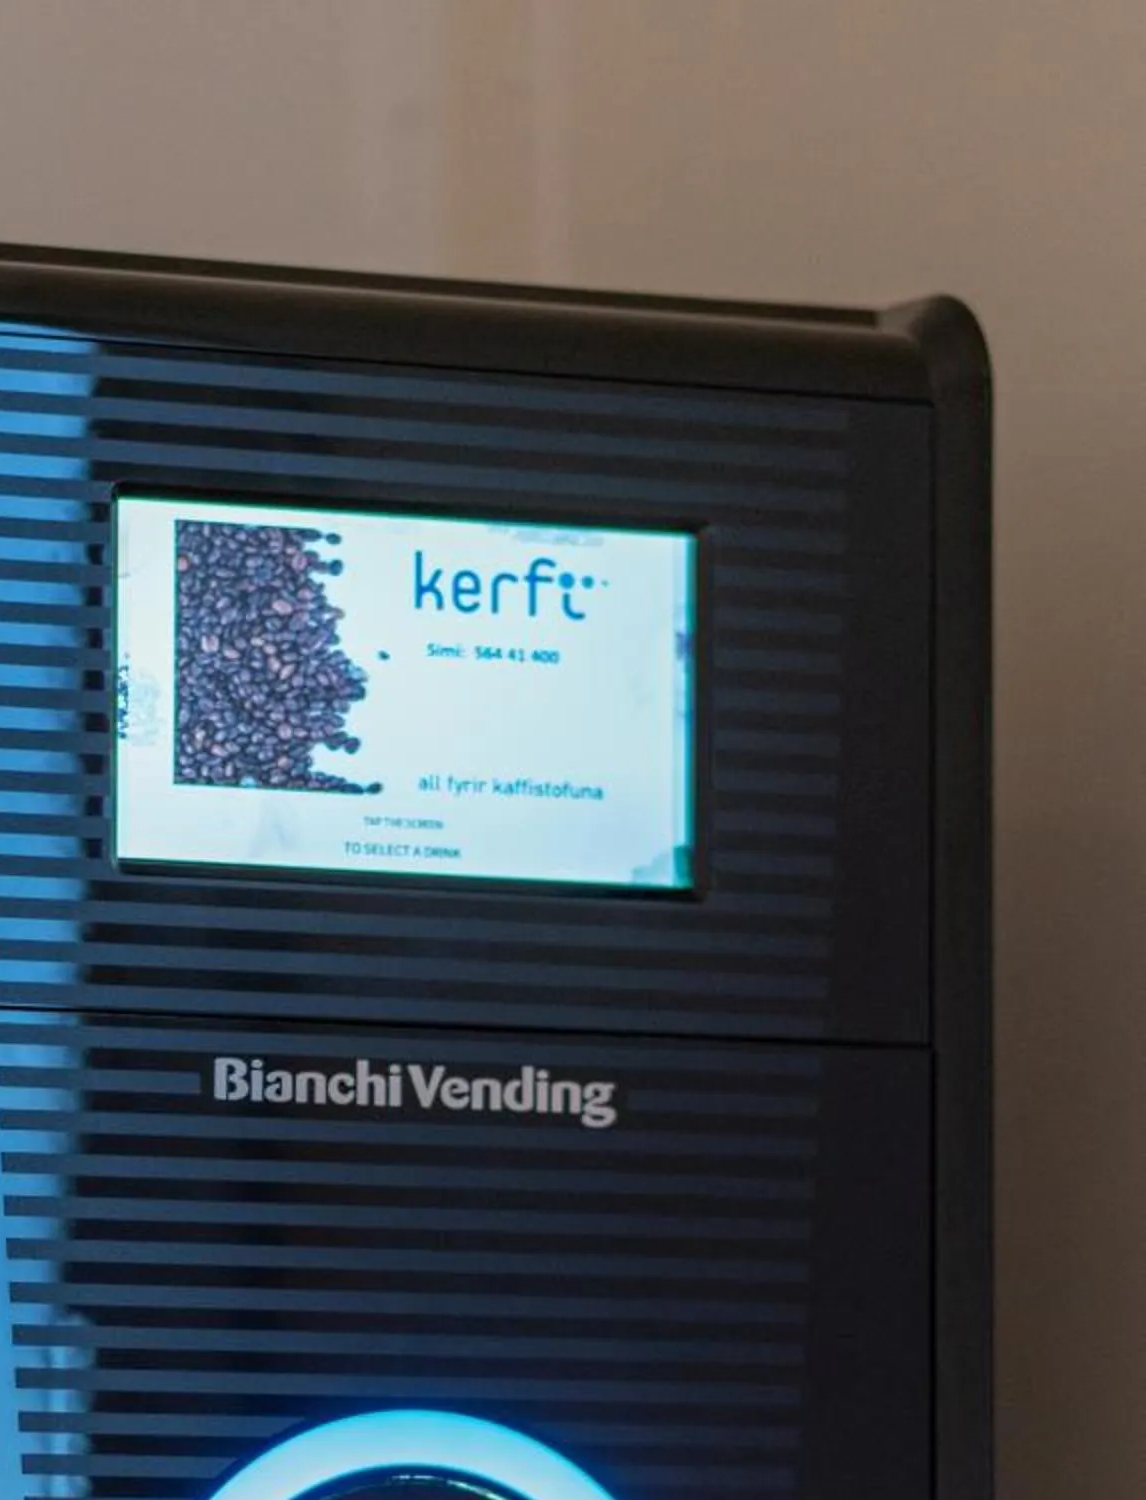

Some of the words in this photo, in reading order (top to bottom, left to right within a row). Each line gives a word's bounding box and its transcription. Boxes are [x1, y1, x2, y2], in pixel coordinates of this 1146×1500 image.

[344, 841, 362, 856] TO
[363, 842, 411, 857] SELECT
[213, 1056, 403, 1108] Bianchi
[407, 1063, 618, 1129] Vending
